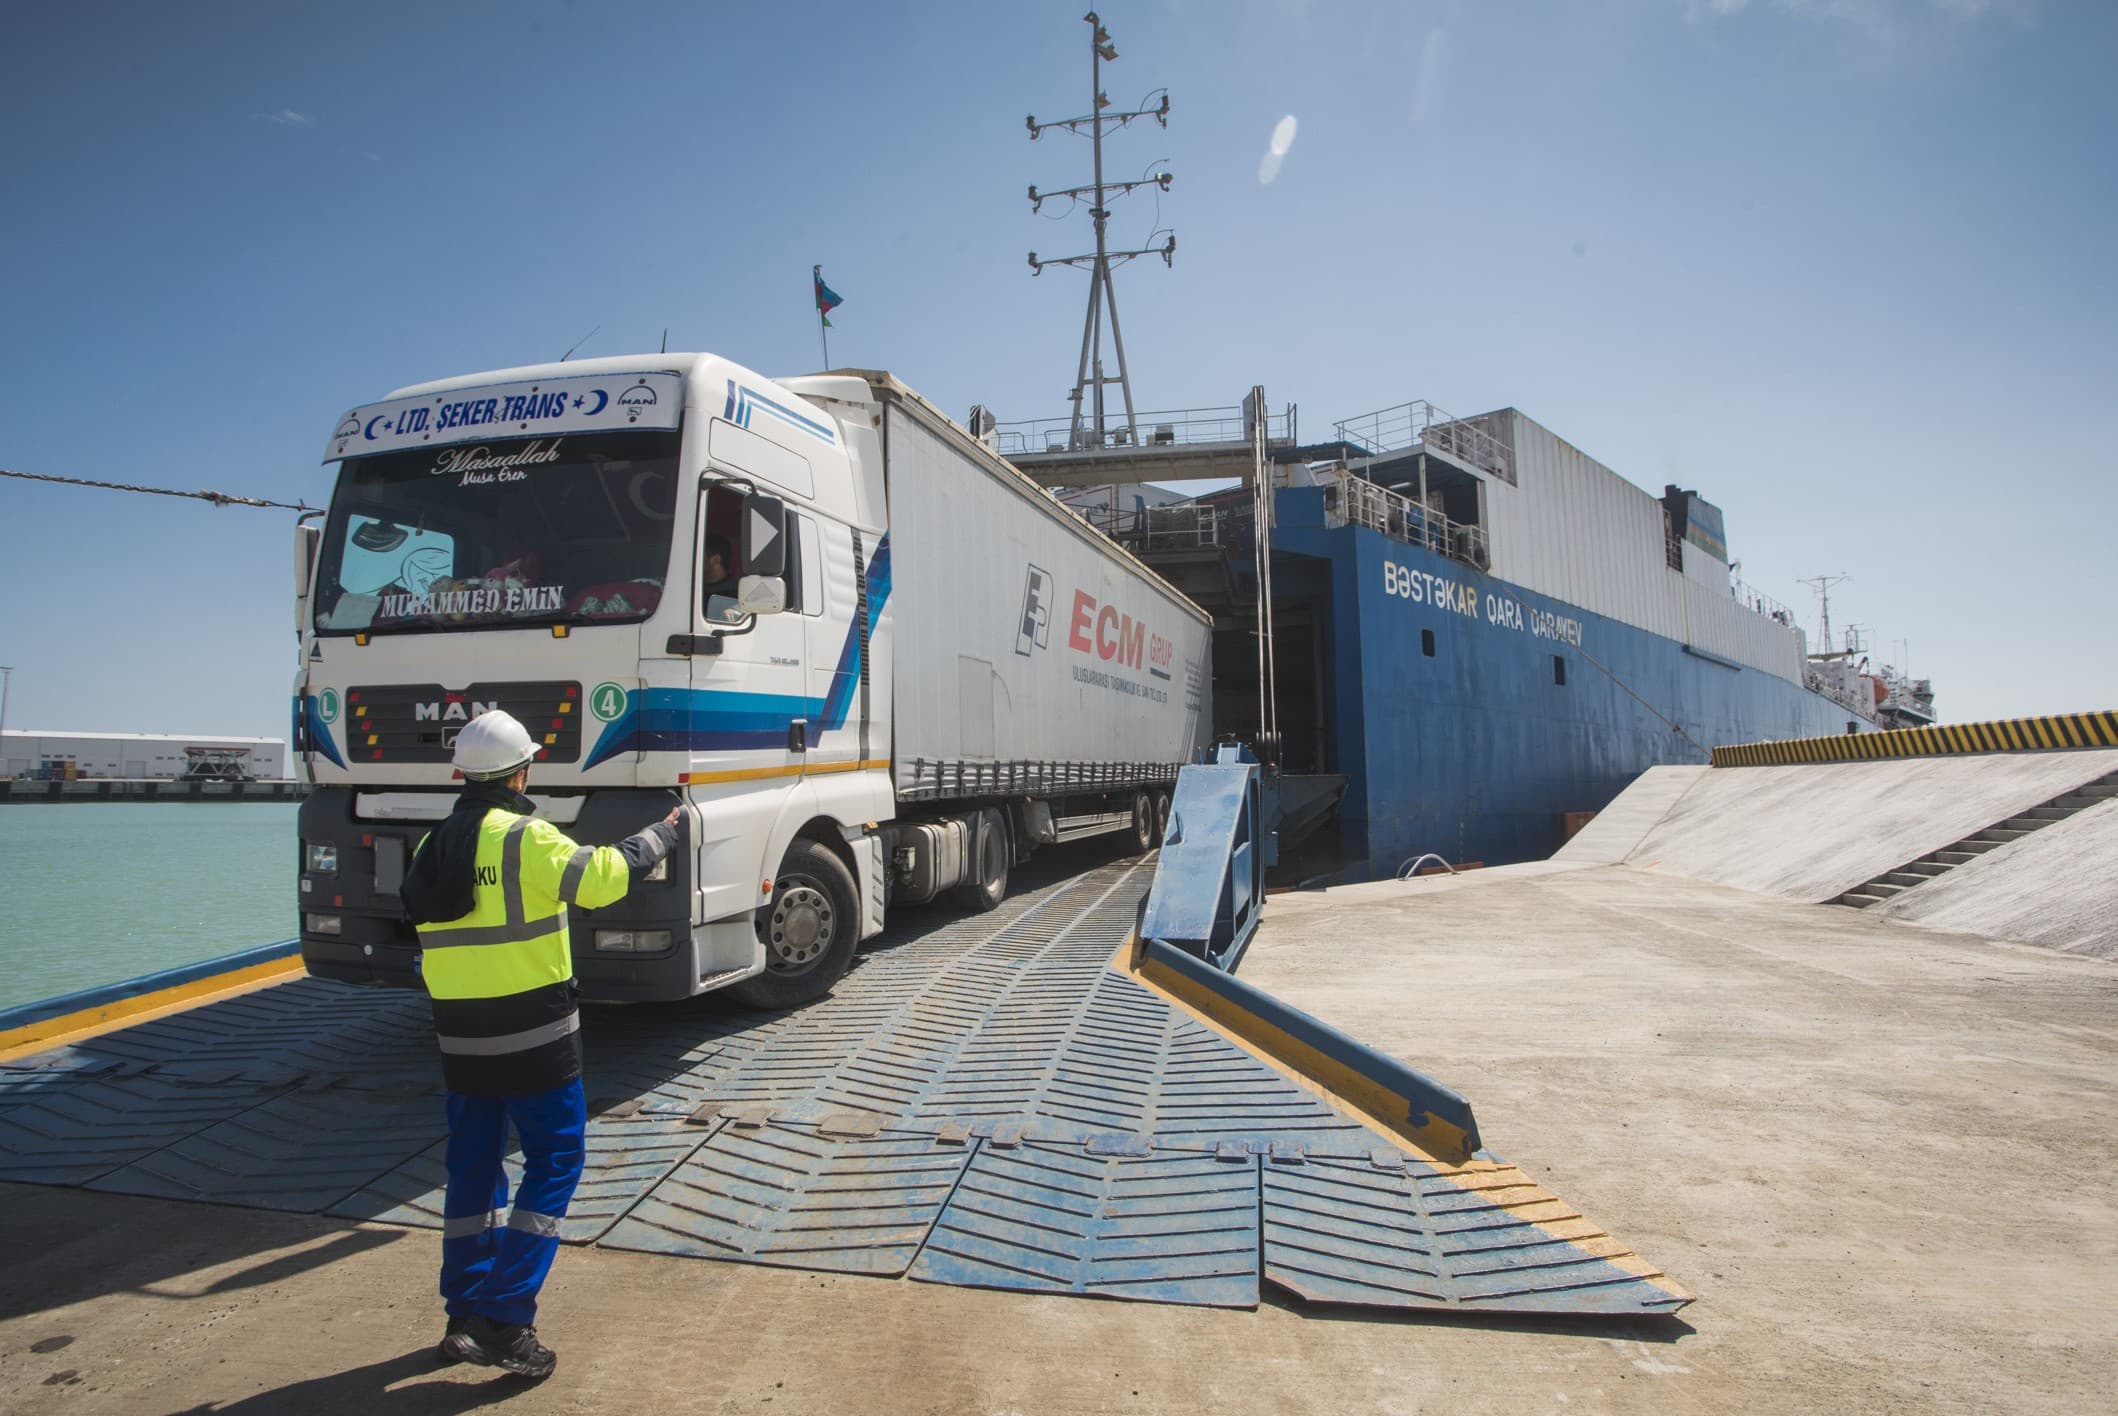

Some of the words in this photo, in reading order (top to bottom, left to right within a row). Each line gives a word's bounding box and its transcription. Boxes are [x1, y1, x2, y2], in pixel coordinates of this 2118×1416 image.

[395, 407, 430, 435] LTD.
[436, 398, 498, 433] ŞEKER
[500, 391, 568, 421] TRANS
[1486, 594, 1524, 631] QARA
[1068, 588, 1146, 671] ECM
[1150, 633, 1173, 669] GRUP
[322, 695, 333, 717] L
[415, 701, 498, 721] MAN
[601, 689, 617, 716] 4
